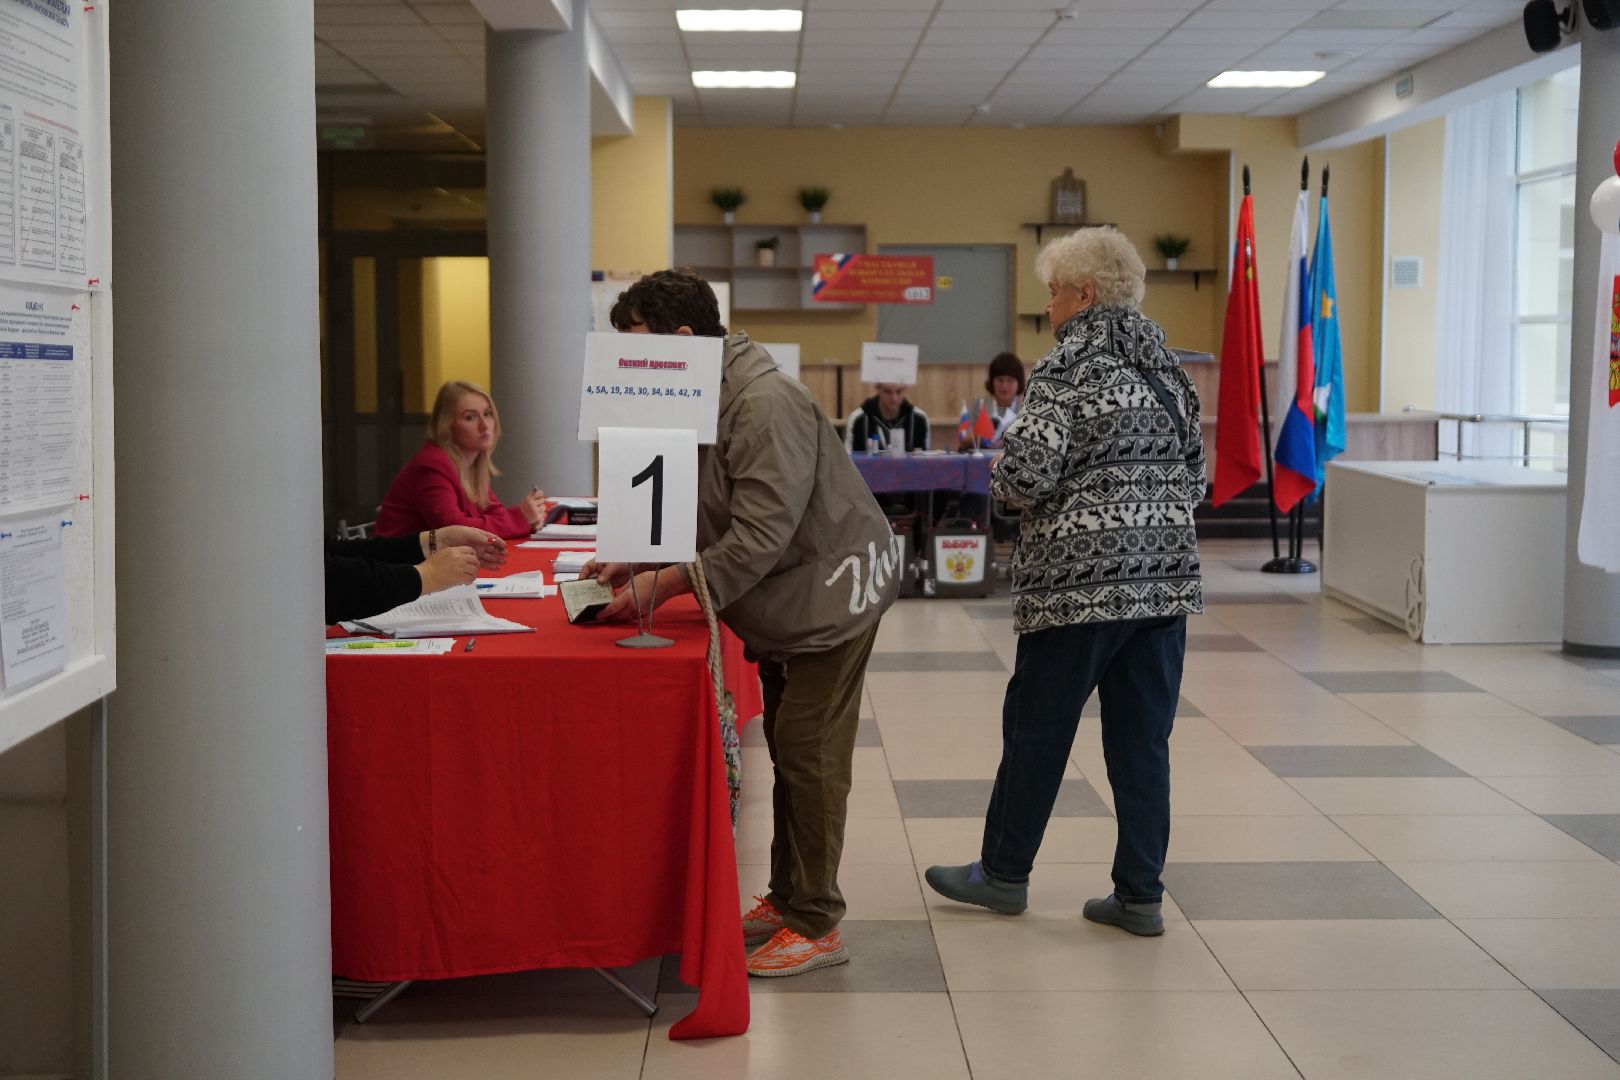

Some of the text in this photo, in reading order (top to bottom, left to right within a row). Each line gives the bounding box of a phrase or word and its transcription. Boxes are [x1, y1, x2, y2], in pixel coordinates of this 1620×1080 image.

[587, 385, 594, 394] 4,
[611, 386, 622, 395] 19,
[624, 386, 636, 395] 28,
[638, 387, 649, 396] 30,
[651, 387, 663, 396] 34,
[665, 388, 676, 397] 36,
[678, 388, 690, 397] 42,
[631, 454, 664, 546] 1
